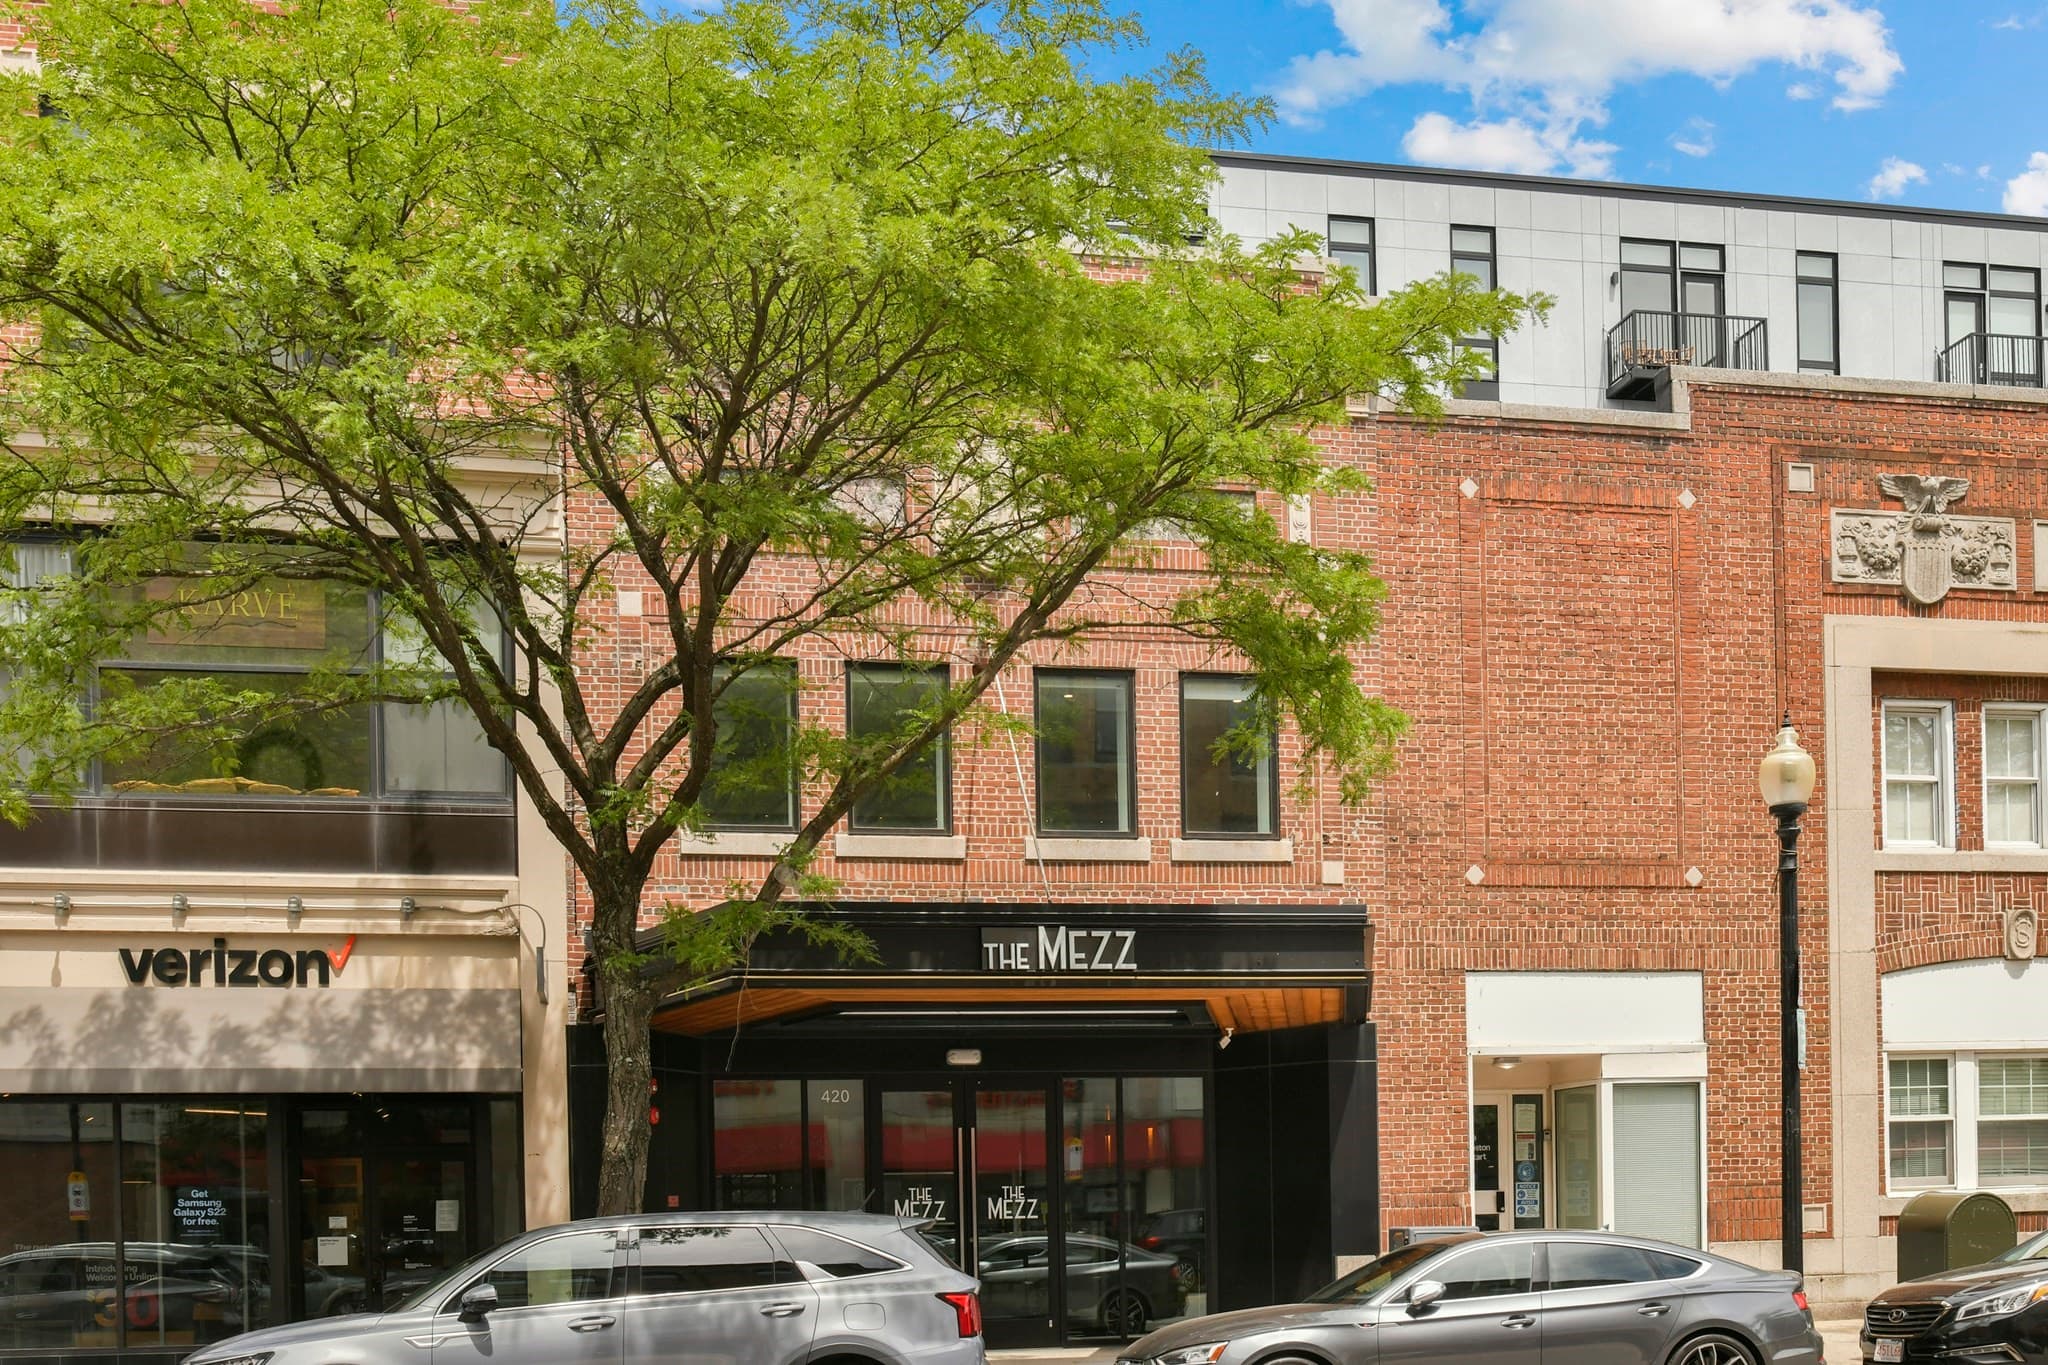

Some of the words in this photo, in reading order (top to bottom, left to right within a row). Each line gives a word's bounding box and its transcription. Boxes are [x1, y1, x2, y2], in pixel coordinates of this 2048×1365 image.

[983, 943, 1030, 970] THE
[1037, 925, 1138, 970] MEZZ
[118, 937, 330, 985] verizon
[820, 1089, 850, 1103] 420
[191, 1189, 208, 1198] Get
[908, 1187, 932, 1200] THE
[1001, 1185, 1025, 1199] THE
[177, 1198, 222, 1208] Samsung
[894, 1199, 946, 1220] MEZZ
[988, 1197, 1039, 1220] MEZZ
[173, 1208, 206, 1218] Galaxy
[207, 1207, 227, 1216] S22
[182, 1217, 196, 1226] for
[197, 1217, 220, 1226] free.
